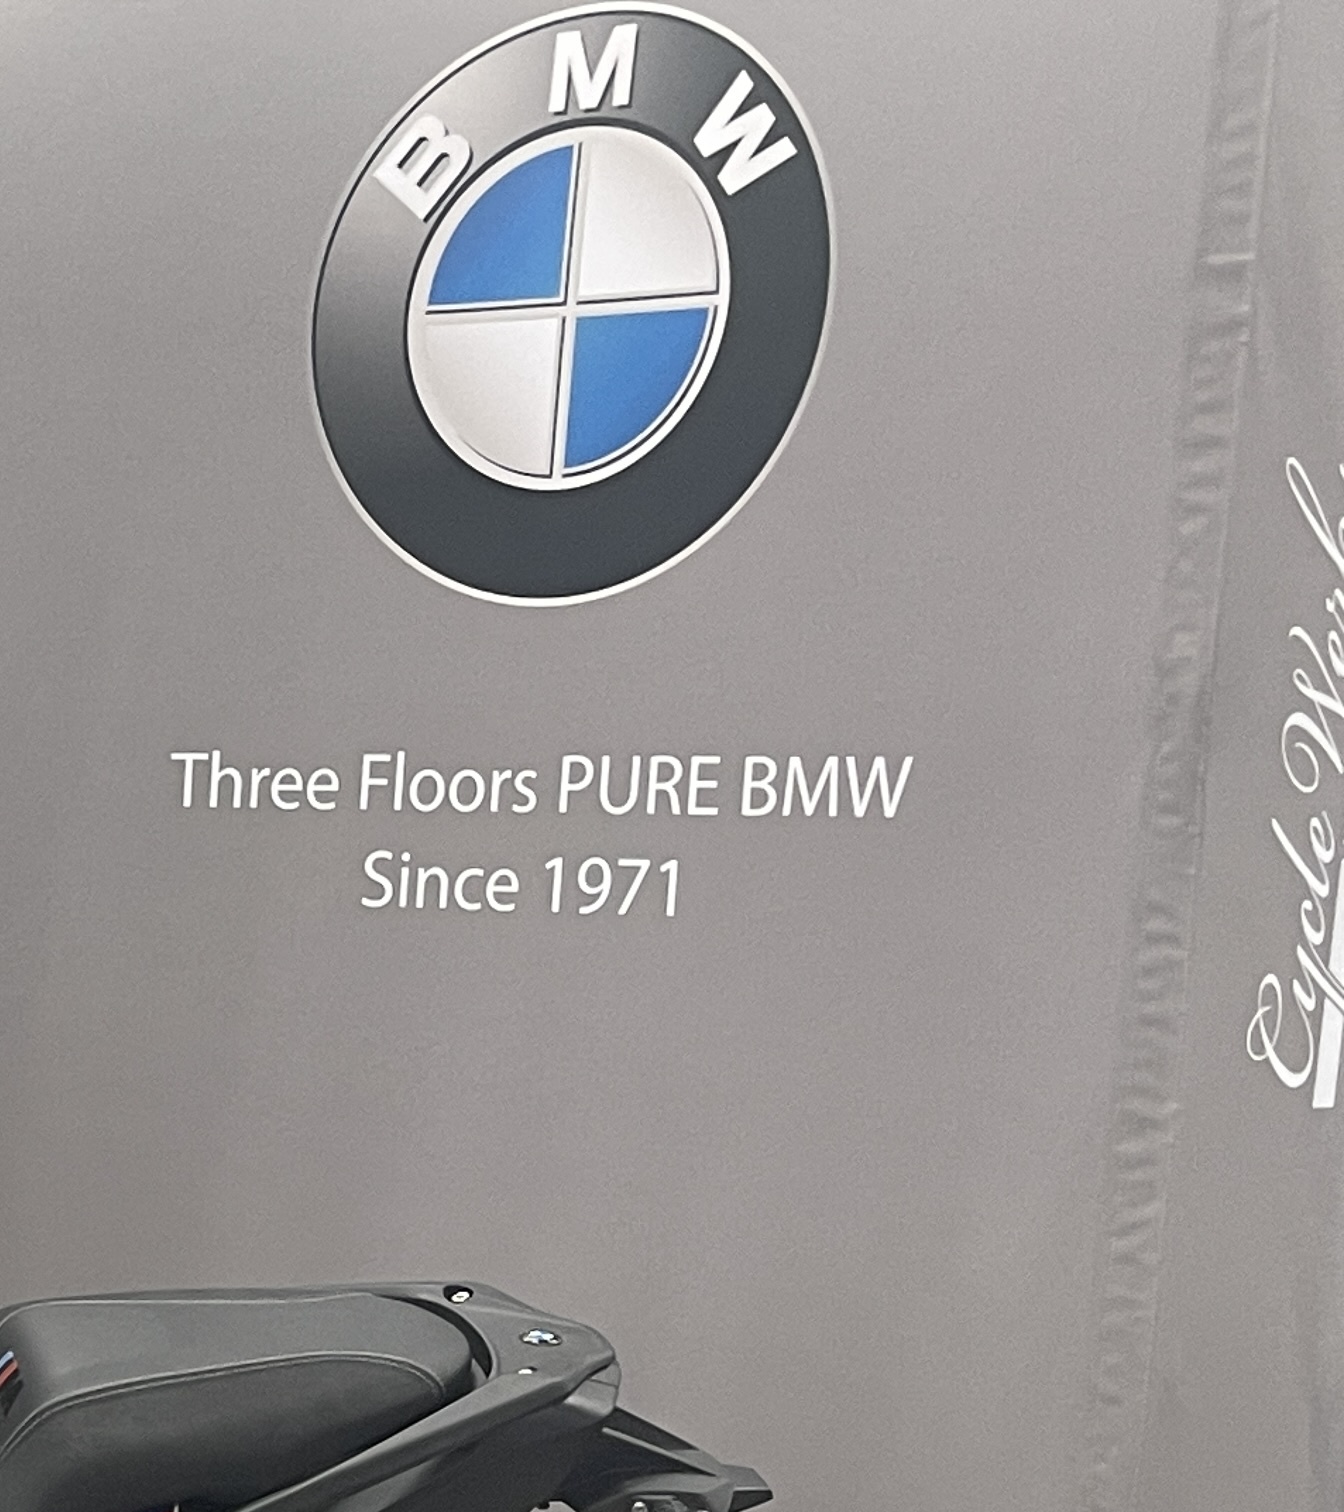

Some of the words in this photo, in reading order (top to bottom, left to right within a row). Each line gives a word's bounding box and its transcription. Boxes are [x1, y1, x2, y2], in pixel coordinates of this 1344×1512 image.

[373, 23, 798, 221] BMW
[169, 748, 341, 812] Three
[358, 749, 539, 814] Floors
[557, 753, 722, 817] PURE
[740, 754, 915, 819] BMW
[360, 848, 521, 913] Since
[543, 855, 680, 918] 1971
